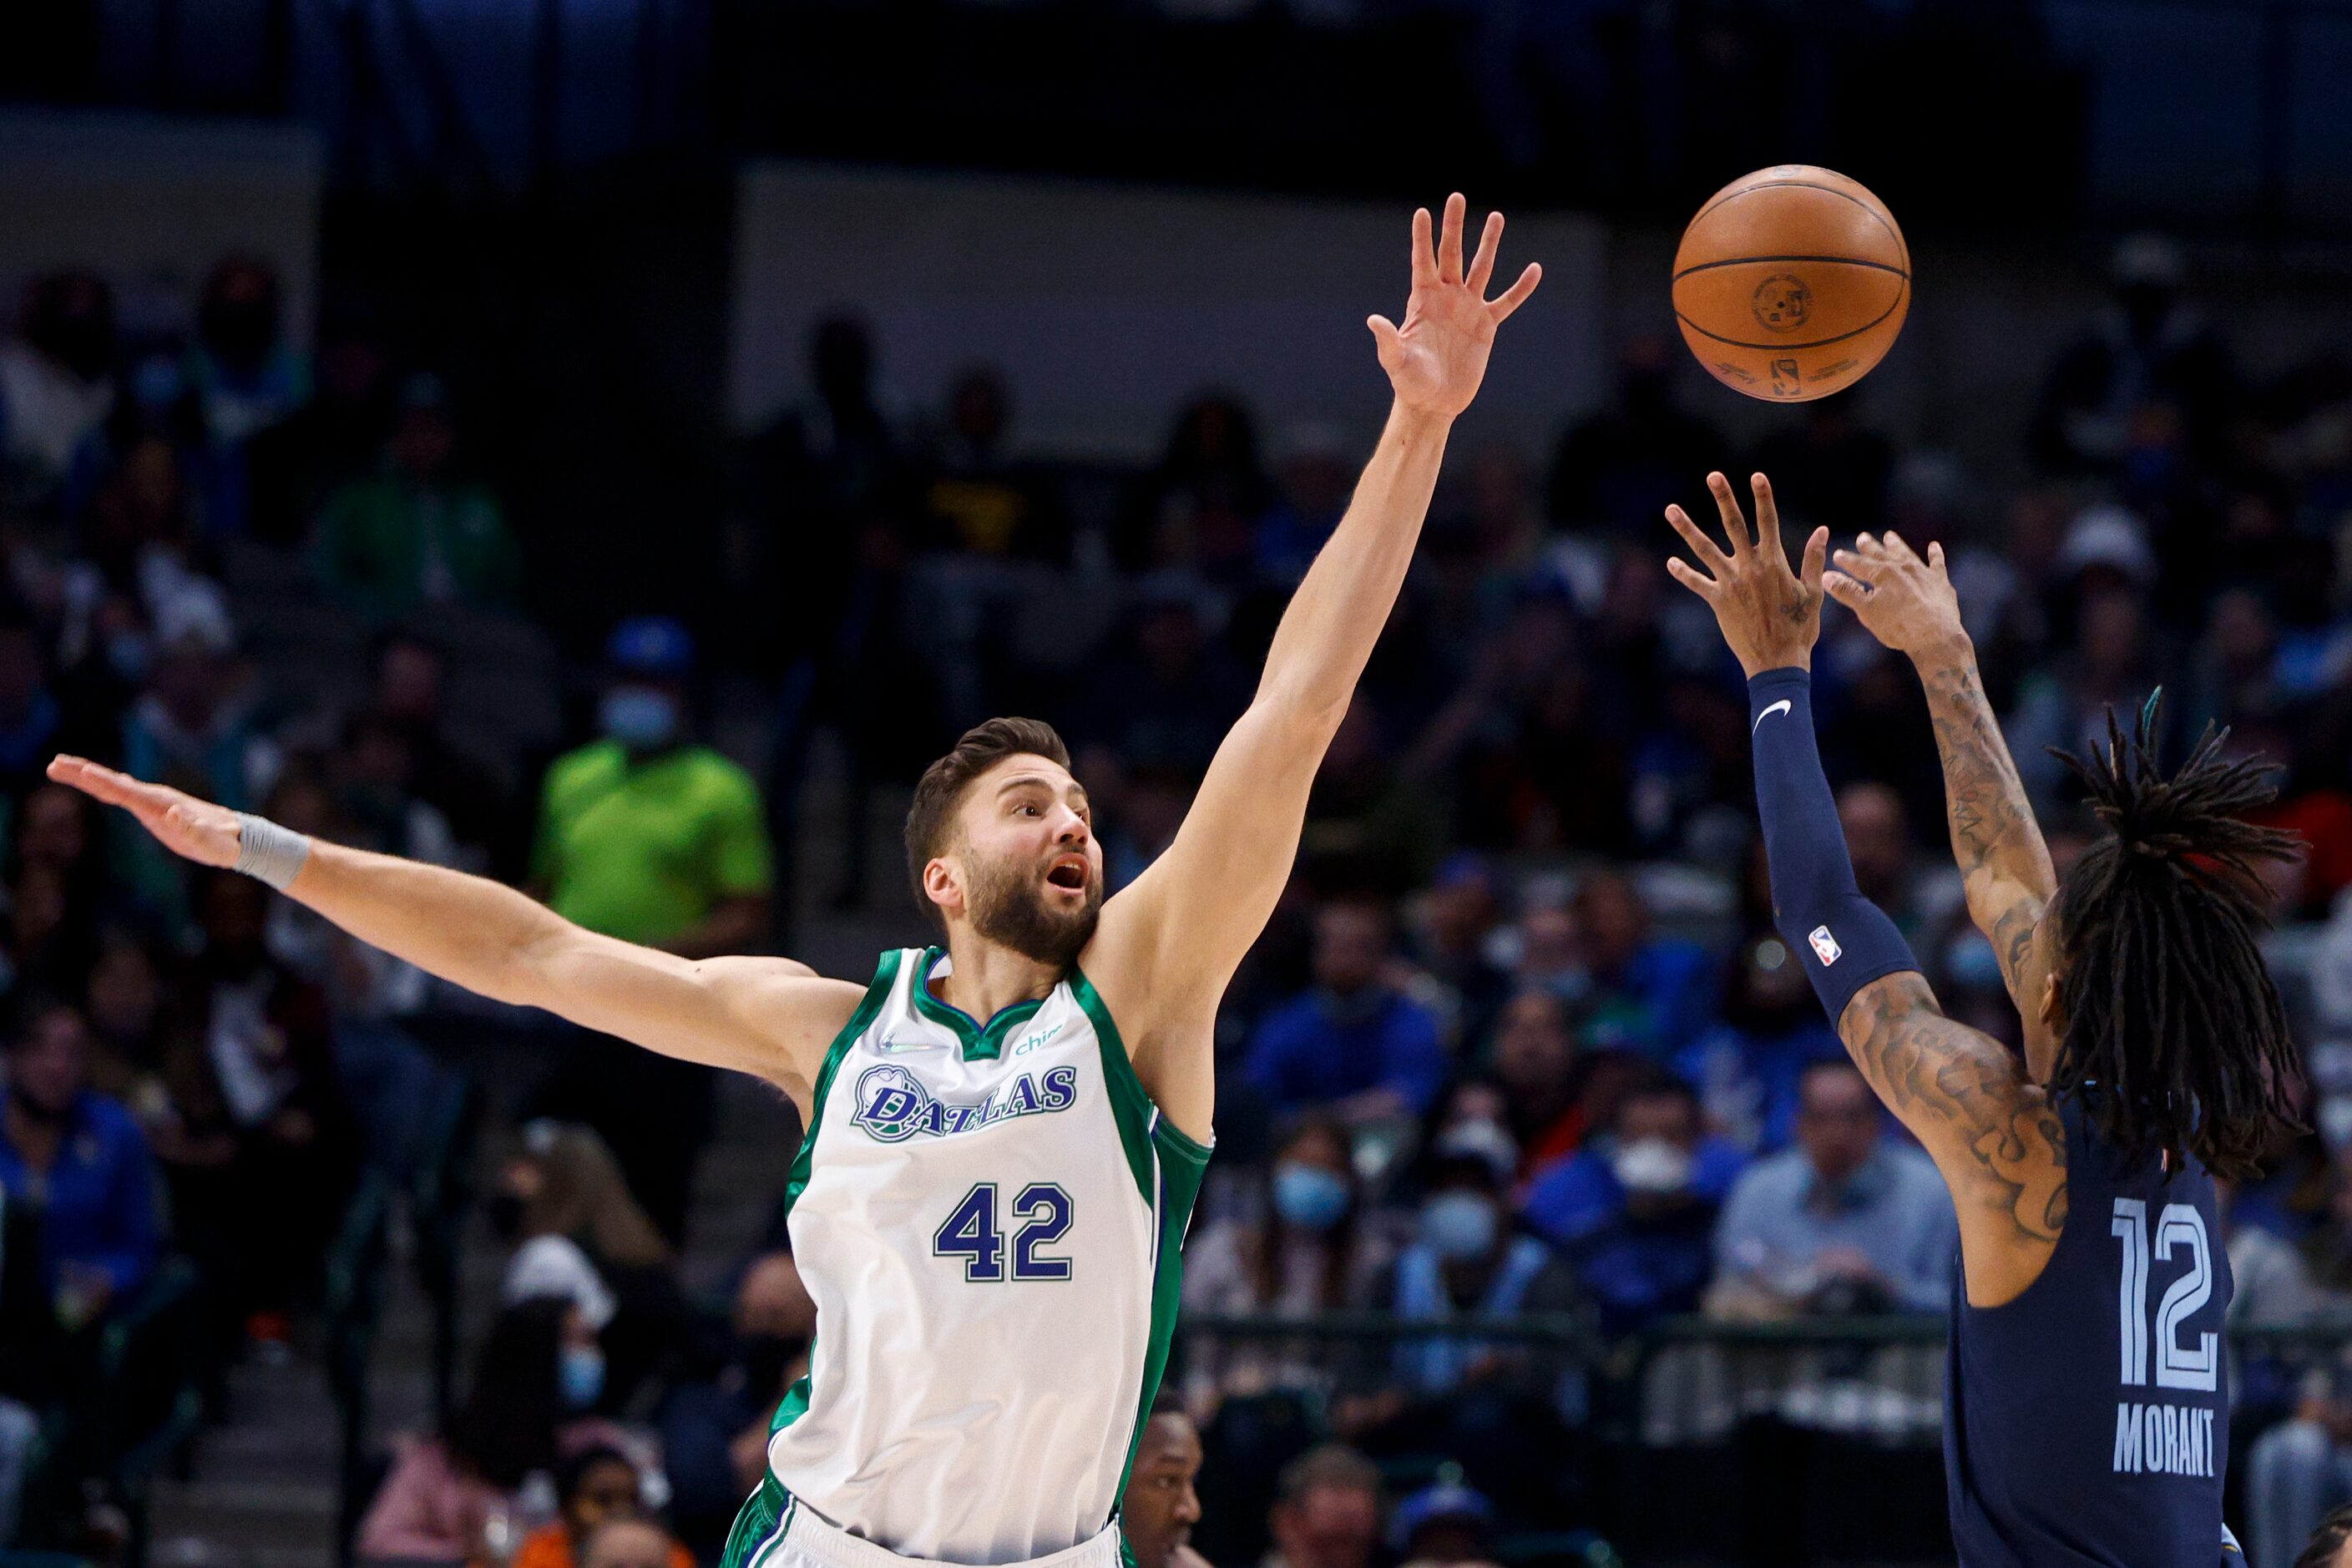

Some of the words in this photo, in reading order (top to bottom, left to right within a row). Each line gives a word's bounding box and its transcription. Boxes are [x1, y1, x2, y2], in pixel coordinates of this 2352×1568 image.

[850, 1066, 1077, 1137] DALLAS
[933, 1182, 1075, 1282] 42
[2111, 1196, 2218, 1392] 12
[2113, 1403, 2214, 1477] MORANT
